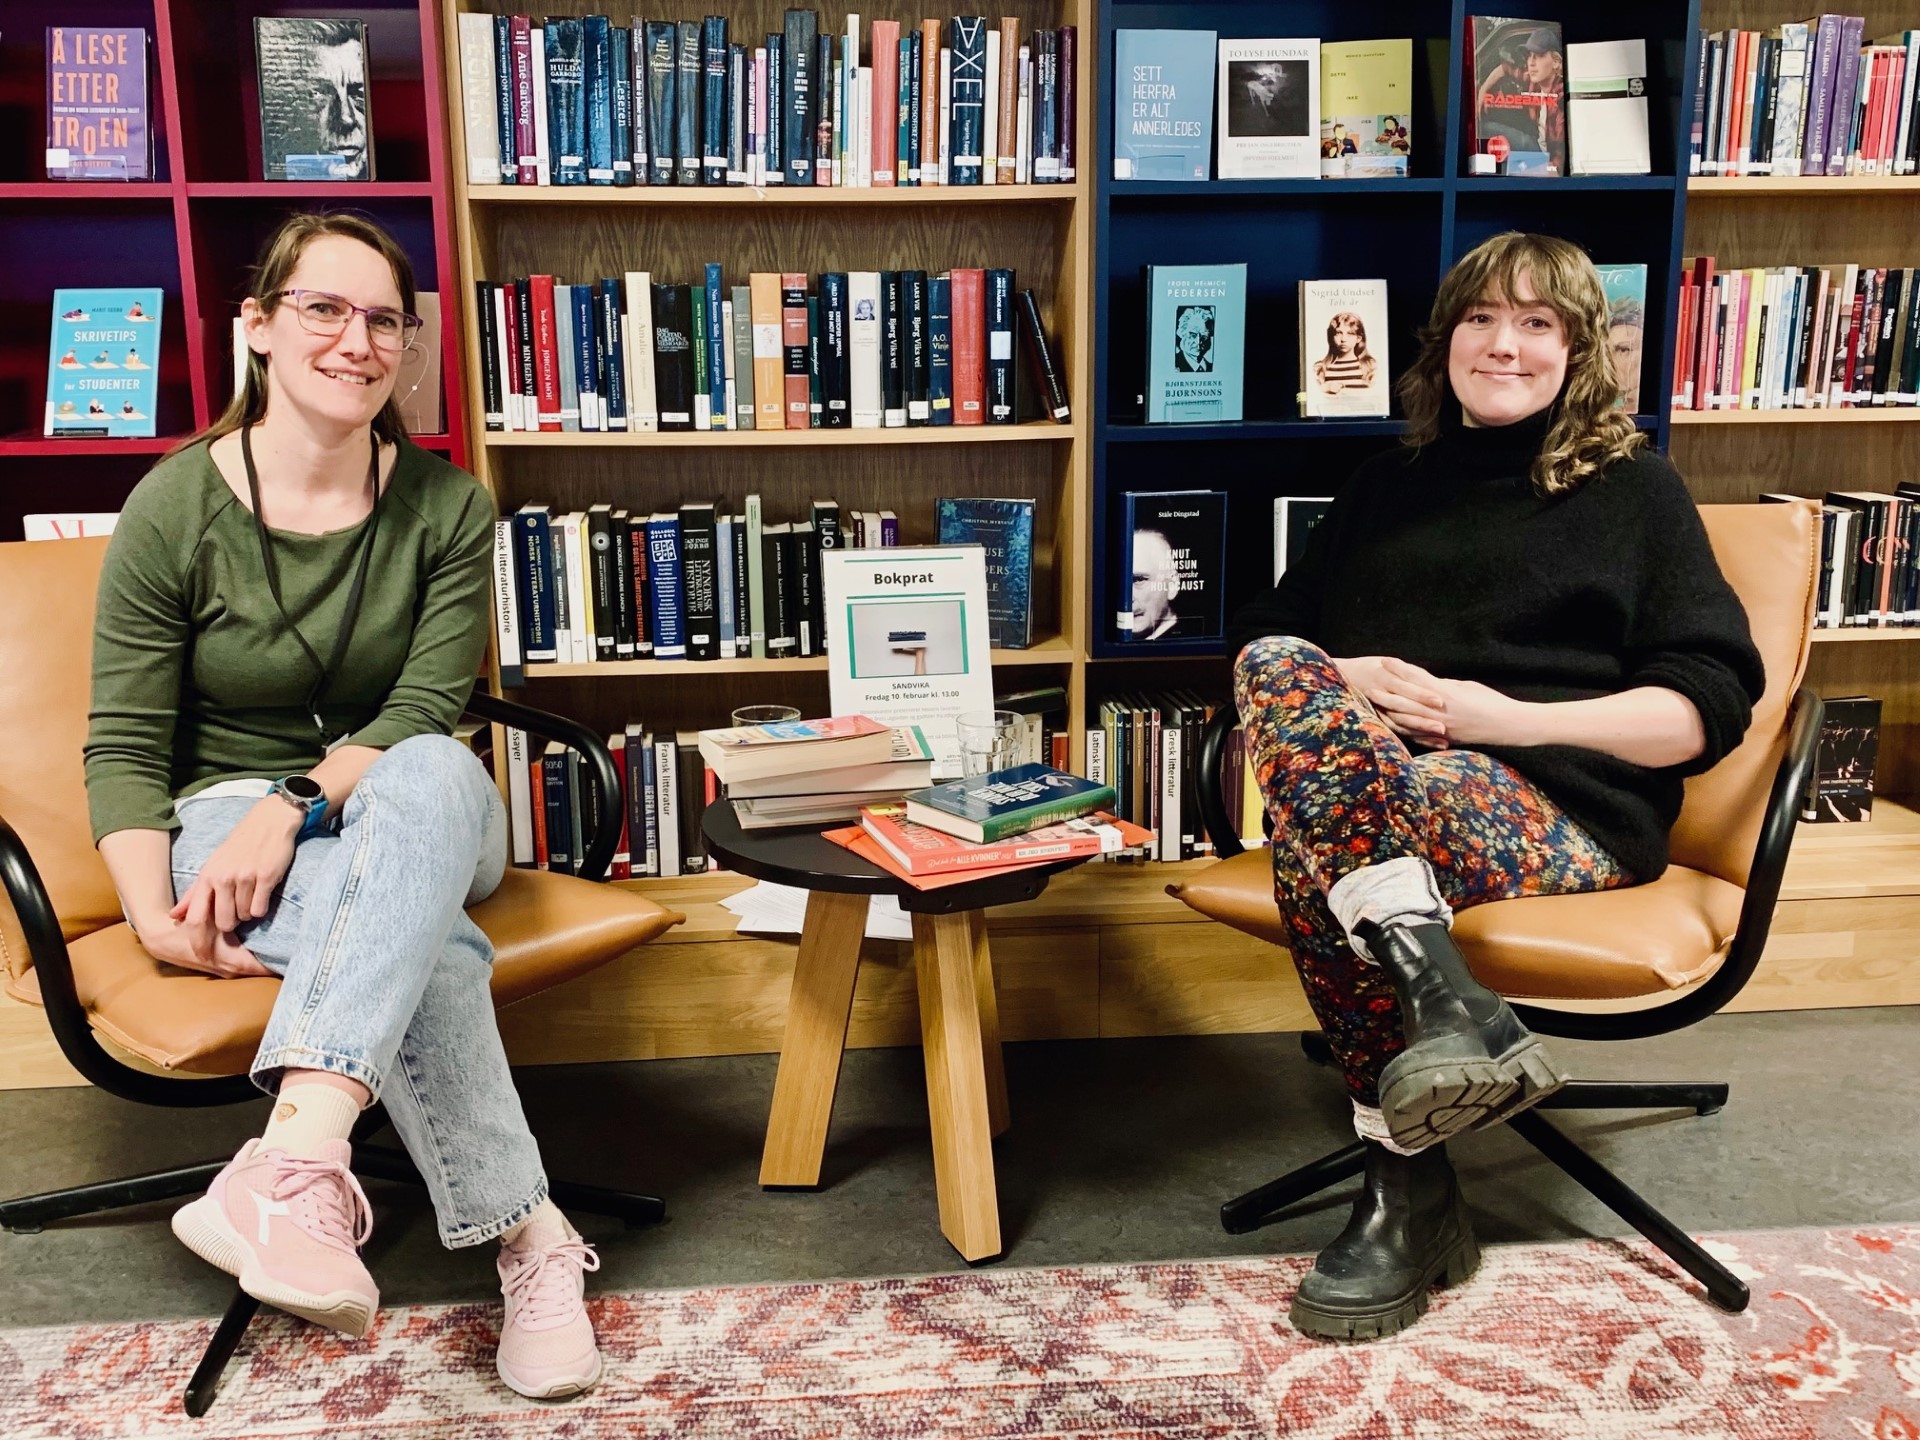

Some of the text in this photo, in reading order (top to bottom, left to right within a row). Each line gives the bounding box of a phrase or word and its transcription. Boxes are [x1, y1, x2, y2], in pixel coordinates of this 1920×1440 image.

[52, 28, 128, 65] Å LESE
[1229, 49, 1309, 58] TO LYSE HUNDAR
[1821, 20, 1835, 77] HENRIK IBSEN
[953, 16, 983, 121] AXEL
[1133, 65, 1163, 82] SETT
[53, 72, 119, 103] ETTER
[517, 50, 532, 126] Arne Garborg
[1133, 84, 1176, 100] HERFRA
[617, 79, 627, 127] Leseren
[1483, 91, 1559, 106] RÅDEBANK
[1815, 88, 1827, 124] SAMLEDE
[1132, 102, 1171, 118] ER ALT
[53, 116, 128, 155] TROEN
[1132, 120, 1201, 137] ANNERLEDES
[1167, 288, 1226, 298] PEDERSEN
[1311, 288, 1375, 297] Sigrid Undset
[888, 317, 897, 339] Bjørg
[912, 316, 921, 338] Bjørg
[74, 331, 137, 342] SKRIVETIPS
[638, 322, 648, 356] Amalie
[522, 345, 532, 384] MIN EGEN
[541, 349, 551, 380] JØRGEN
[890, 358, 898, 369] vei
[914, 356, 922, 368] vei
[79, 379, 140, 390] STUDENTER
[1165, 380, 1223, 388] BJØRNSTJERNE
[1165, 389, 1223, 398] BJØRNSONS
[1173, 510, 1200, 518] Dingstad
[984, 547, 1004, 557] USE
[1166, 548, 1191, 560] KNUT
[1158, 559, 1198, 570] HAMSUN
[497, 521, 513, 634] Norsk litteraturhistorie
[685, 559, 697, 613] HISTORIE
[701, 559, 712, 612] NYNORSK
[873, 572, 934, 587] Bokprat
[1150, 580, 1205, 592] HOLOCAUST
[530, 563, 542, 644] LITTERATURHISTORIE
[892, 682, 930, 690] SANDVIKA
[865, 694, 890, 702] Fredag
[903, 692, 930, 700] februar
[1091, 731, 1101, 783] Latinsk litte
[1167, 729, 1177, 798] Gresk litteratur
[661, 743, 671, 816] Fransk litteratur
[645, 785, 655, 828] HERFRA TIL
[956, 853, 970, 864] ALLE
